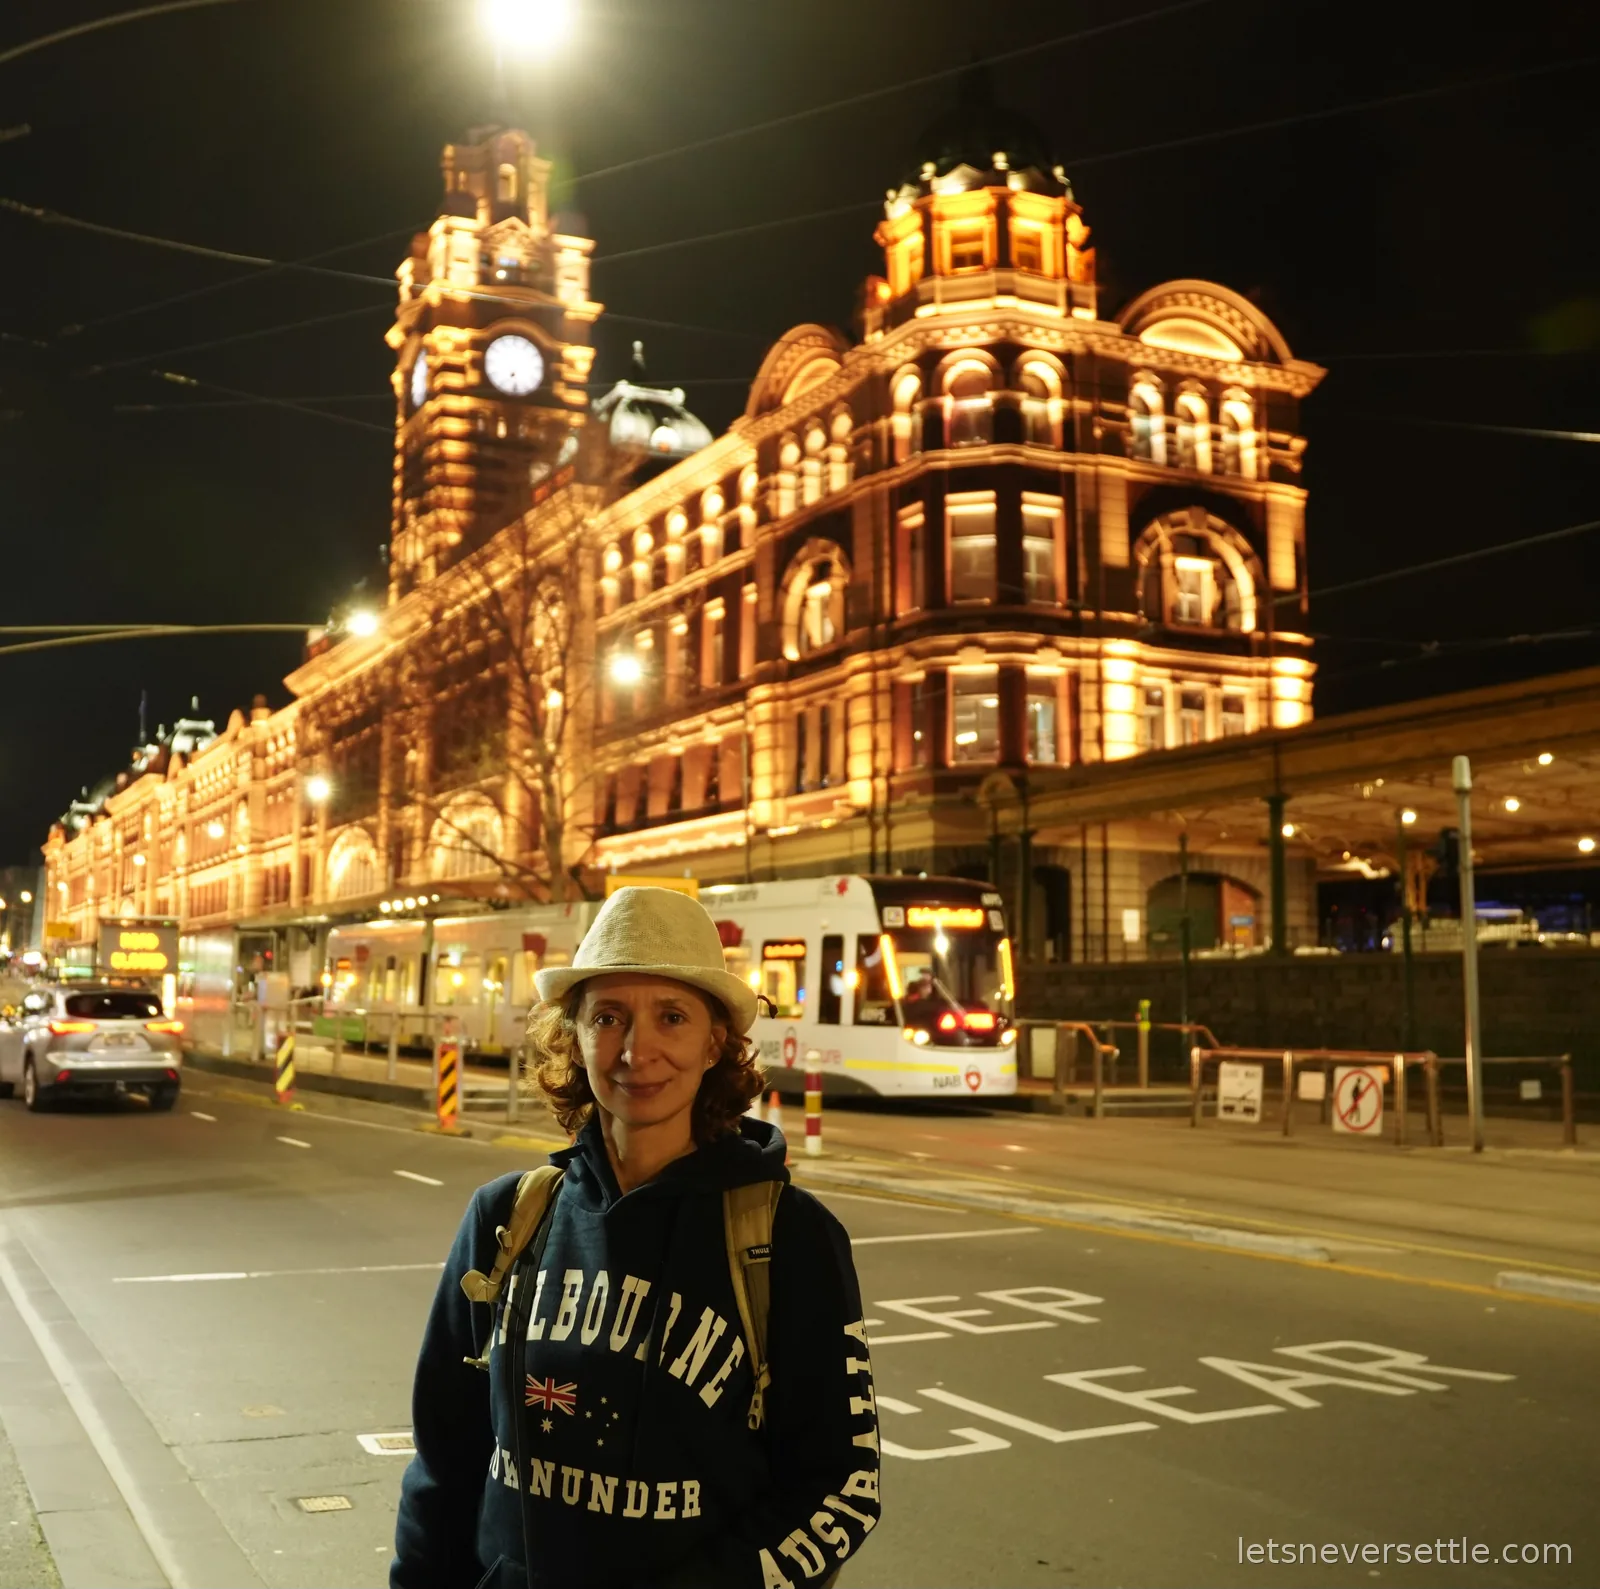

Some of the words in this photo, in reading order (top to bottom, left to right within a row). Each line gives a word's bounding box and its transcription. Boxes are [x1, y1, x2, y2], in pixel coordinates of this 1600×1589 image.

[490, 1269, 745, 1409] LBOUNE
[864, 1285, 1105, 1346] EP
[874, 1340, 1517, 1460] CLEAR
